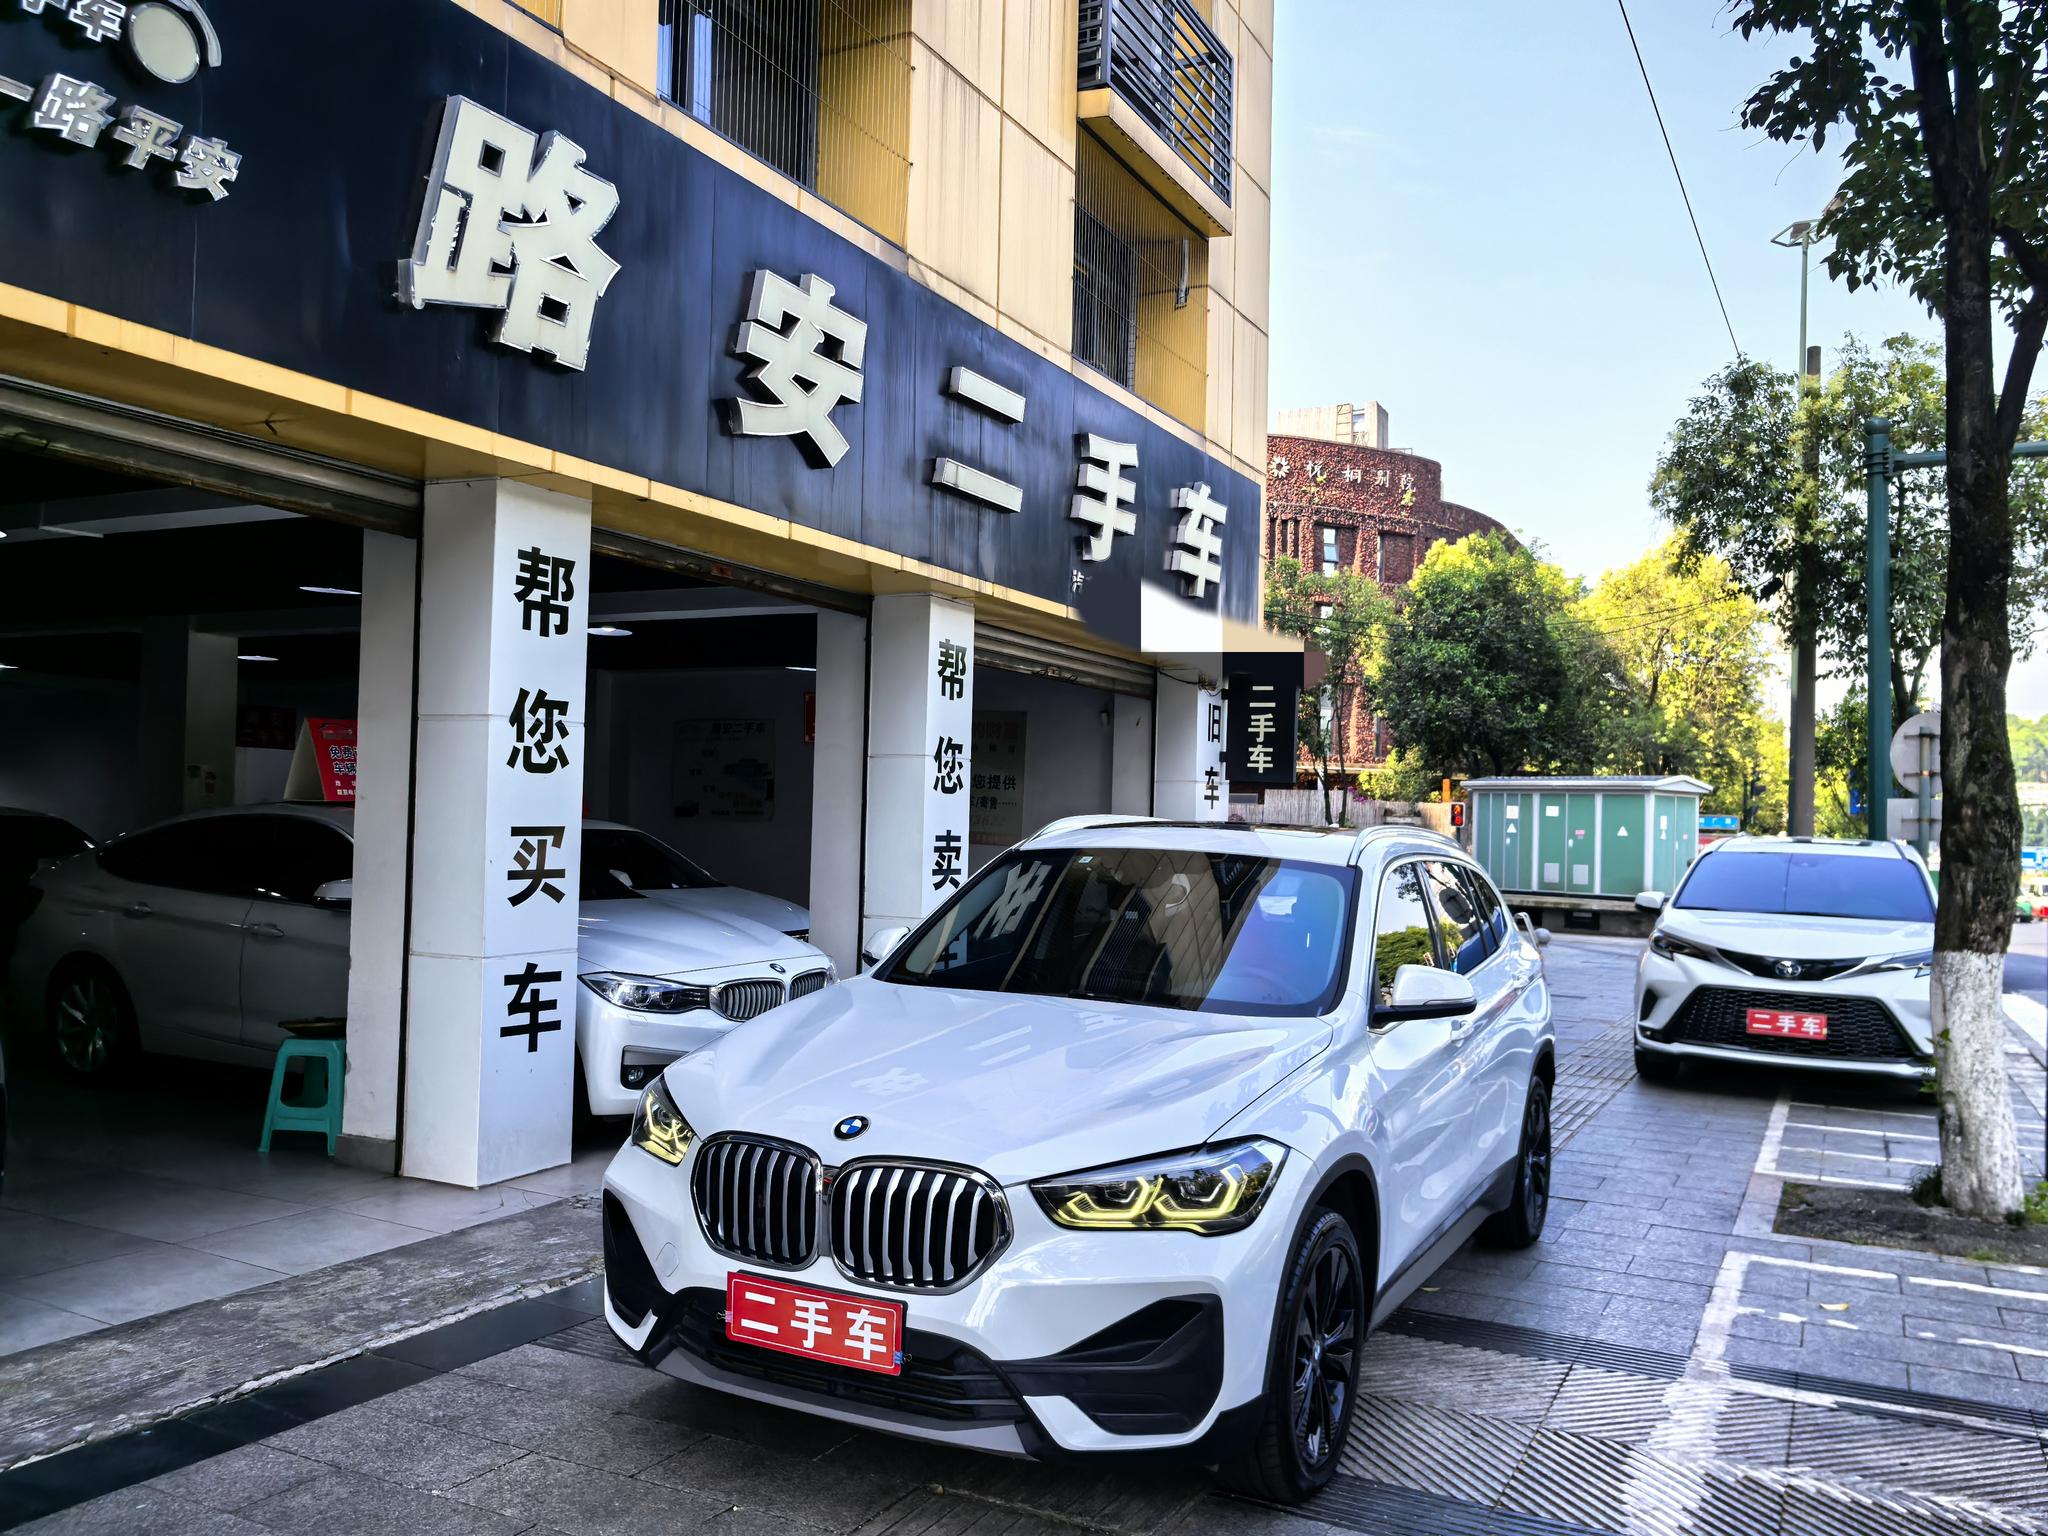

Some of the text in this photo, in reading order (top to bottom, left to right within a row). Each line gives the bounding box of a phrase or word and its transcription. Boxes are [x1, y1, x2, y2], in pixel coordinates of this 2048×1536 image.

[22, 0, 127, 43] 车
[397, 93, 1228, 600] 路安二手车
[329, 745, 357, 759] 免费
[1204, 702, 1222, 810] 旧车
[1247, 685, 1276, 774] 二手车
[500, 546, 576, 1053] 帮您买车
[1752, 1013, 1822, 1036] 二手车
[738, 1289, 888, 1361] 二手车
